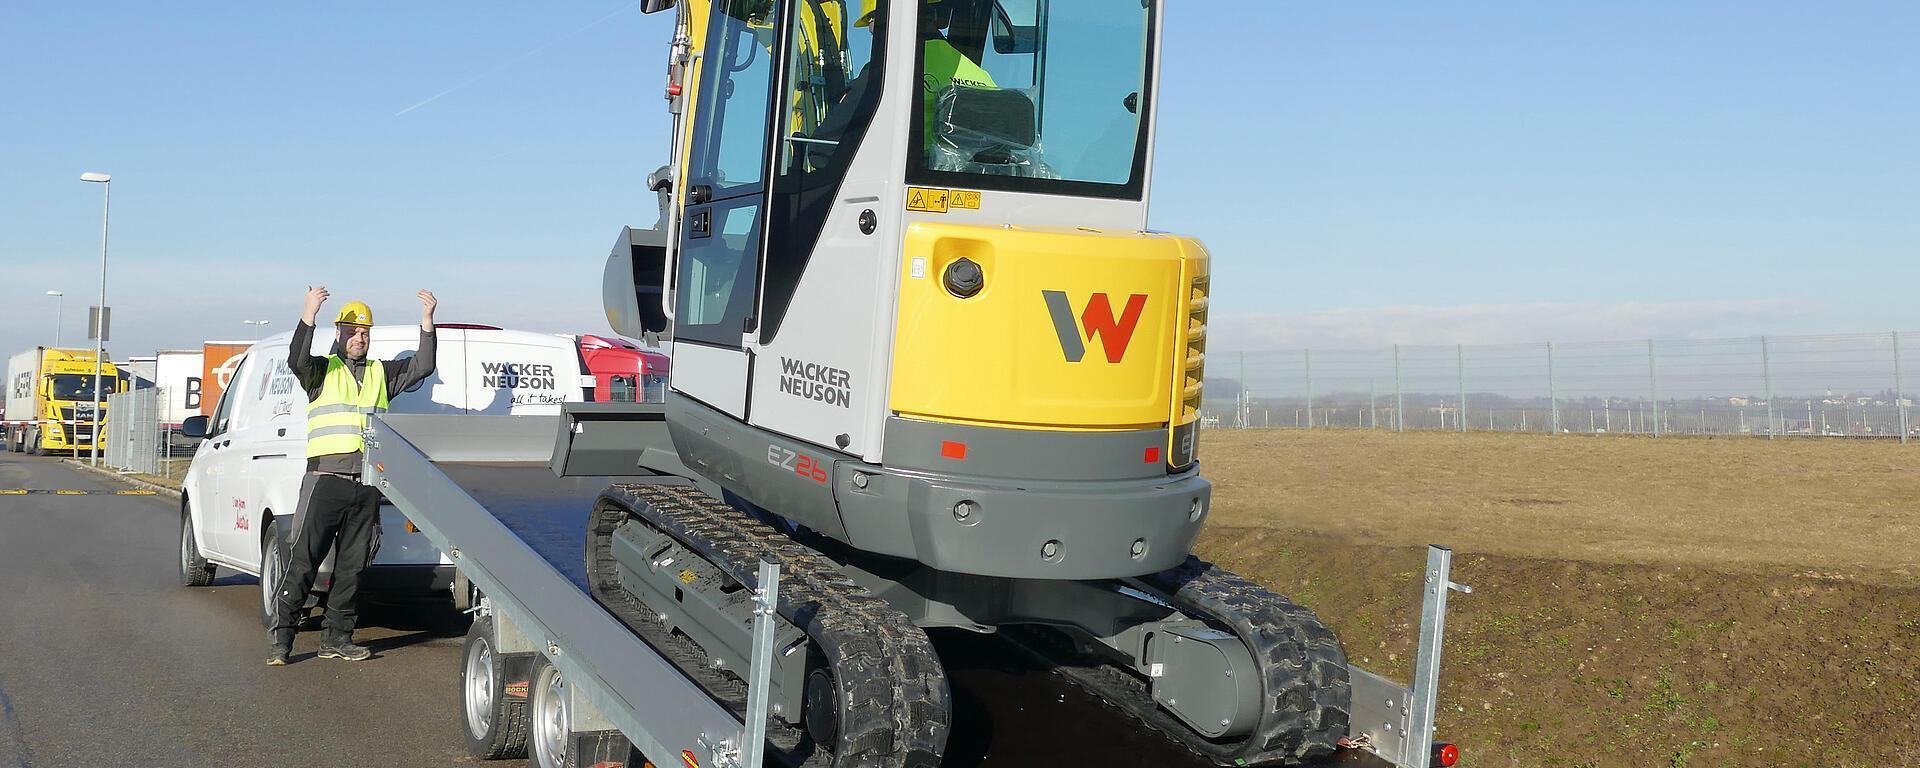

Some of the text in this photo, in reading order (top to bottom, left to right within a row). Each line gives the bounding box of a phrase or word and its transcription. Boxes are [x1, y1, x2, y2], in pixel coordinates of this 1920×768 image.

[950, 76, 987, 87] WACK
[1041, 289, 1149, 364] W
[481, 361, 554, 377] WACKER
[780, 356, 851, 390] WACKER
[482, 375, 554, 390] NEUSON
[511, 394, 524, 405] all
[527, 393, 537, 403] it
[779, 375, 851, 409] NEUSON
